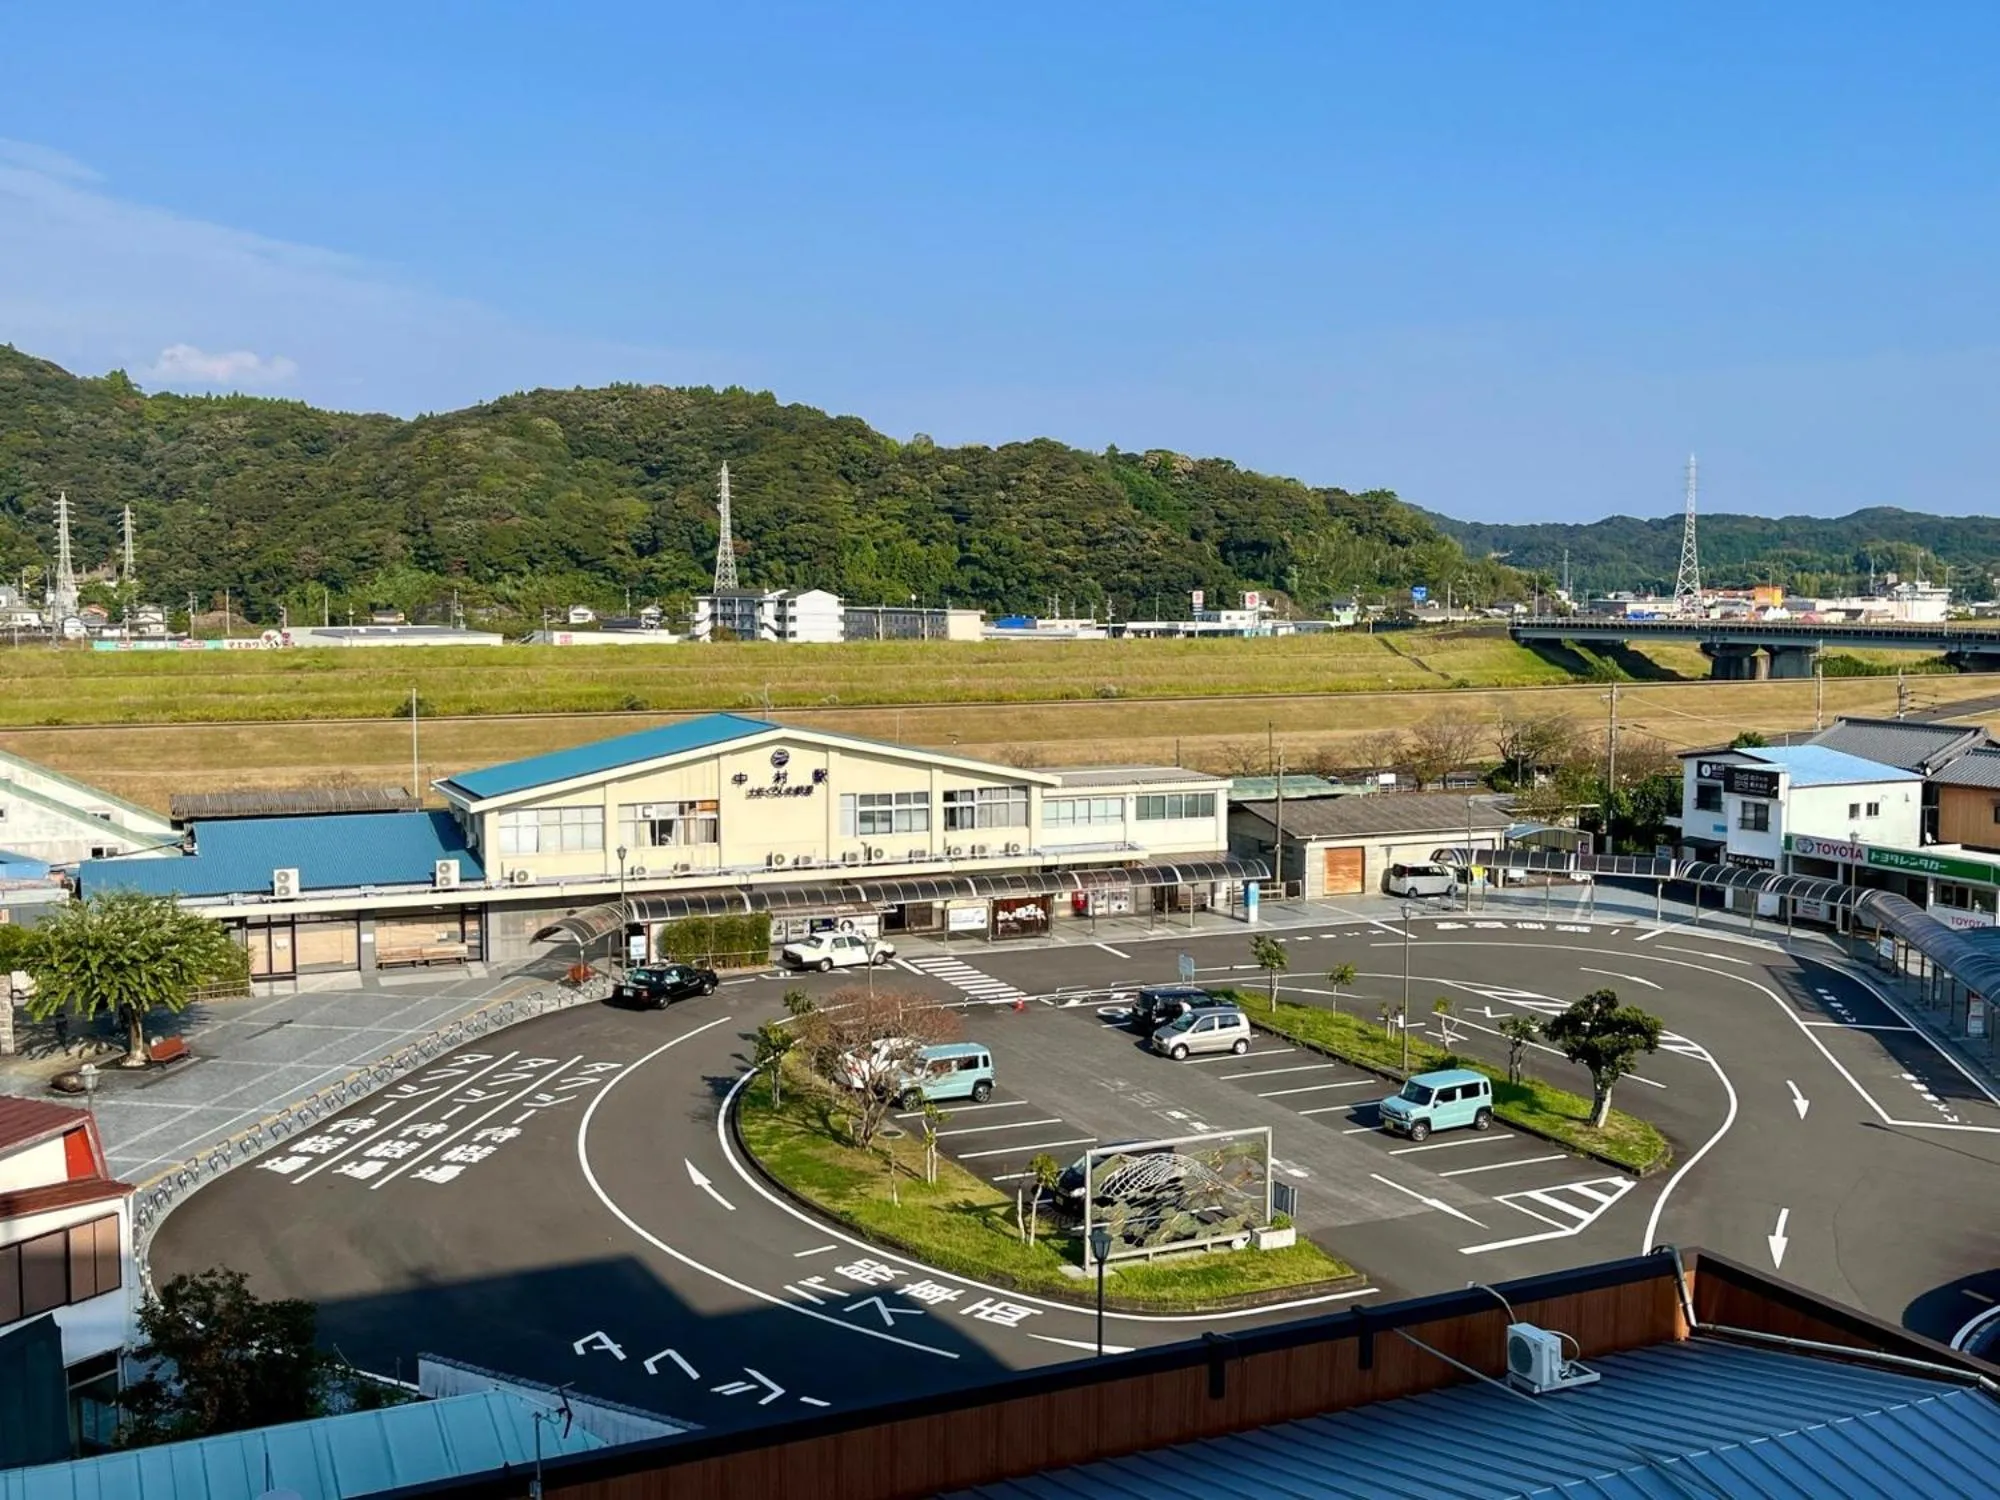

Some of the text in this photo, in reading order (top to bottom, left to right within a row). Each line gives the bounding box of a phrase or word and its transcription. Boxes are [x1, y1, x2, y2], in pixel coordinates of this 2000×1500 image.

[1815, 842, 1864, 861] TOYOTA
[1870, 851, 1949, 871] トヨタレンタカー
[573, 1330, 832, 1407] タクシー
